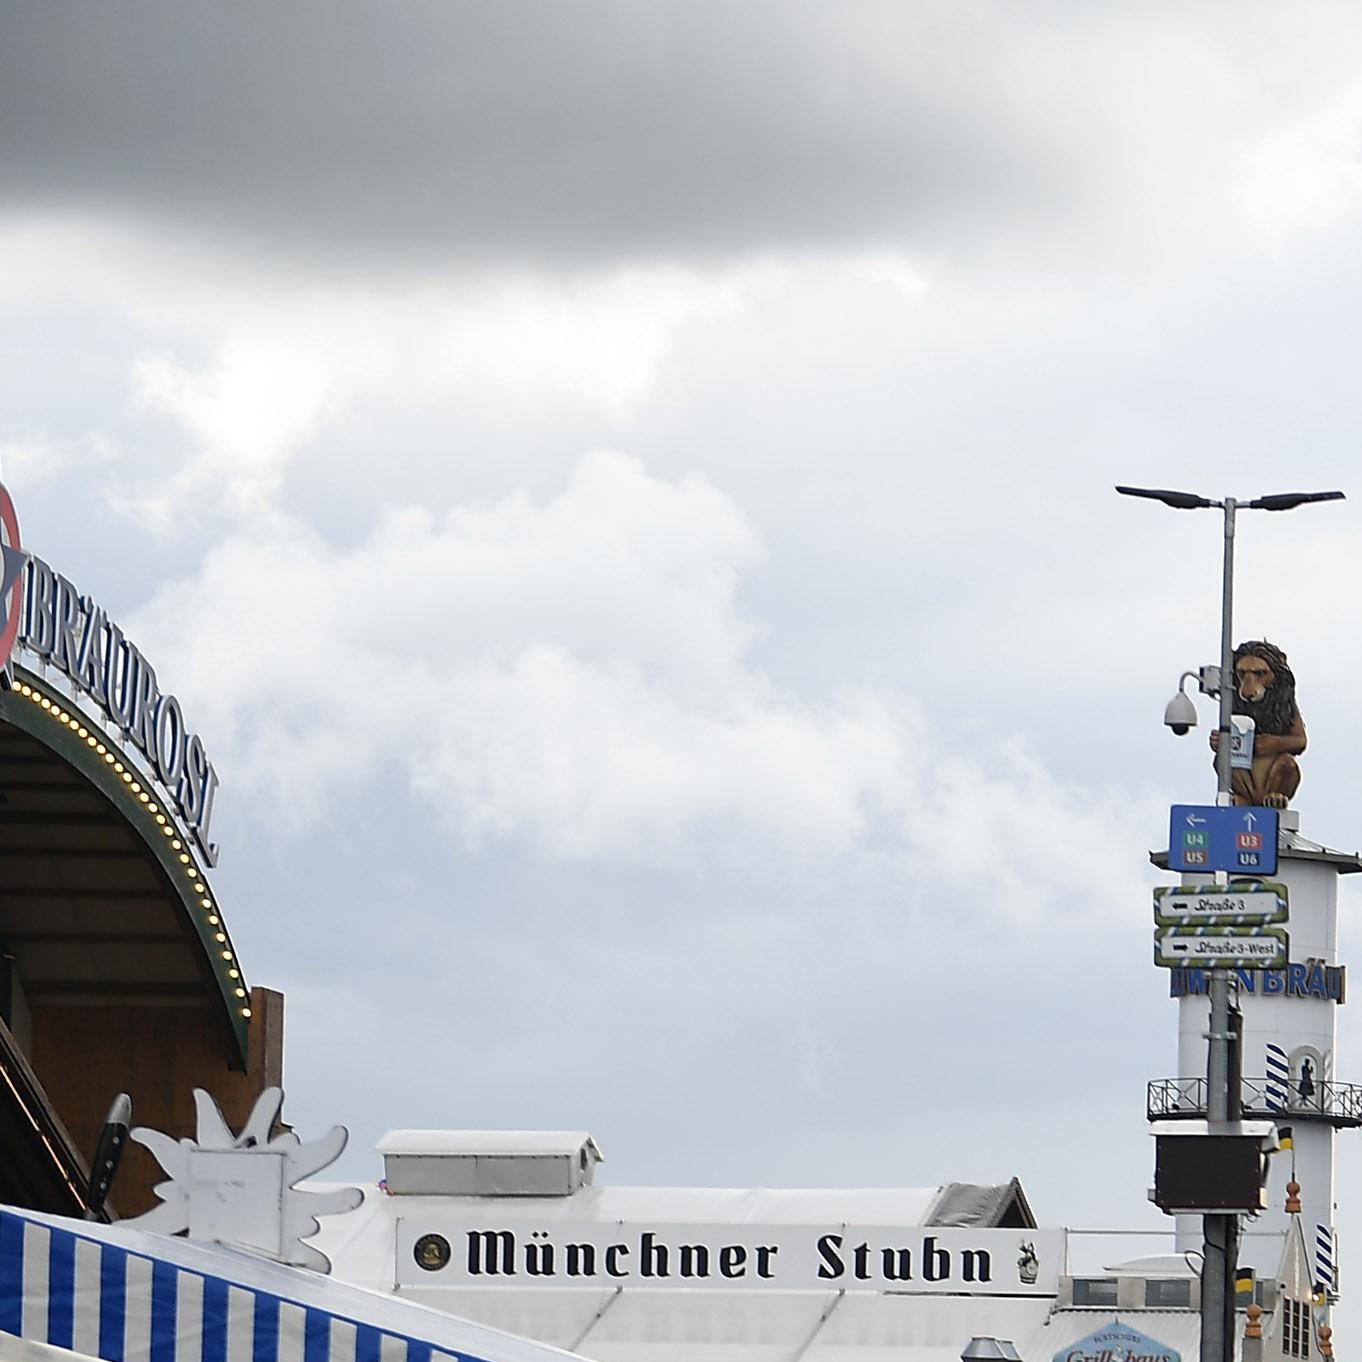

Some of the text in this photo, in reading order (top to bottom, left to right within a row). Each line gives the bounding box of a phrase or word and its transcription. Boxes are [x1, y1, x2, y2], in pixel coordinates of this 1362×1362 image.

[23, 553, 219, 869] BRÄUROSL
[1186, 834, 1205, 845] U4
[1240, 835, 1258, 847] U3
[1186, 852, 1205, 864] U5
[1240, 854, 1258, 865] U6
[1194, 898, 1246, 911] Straße 3
[1194, 941, 1275, 955] Straße 3-West
[466, 1230, 779, 1279] Münchner
[816, 1234, 993, 1282] Stubn
